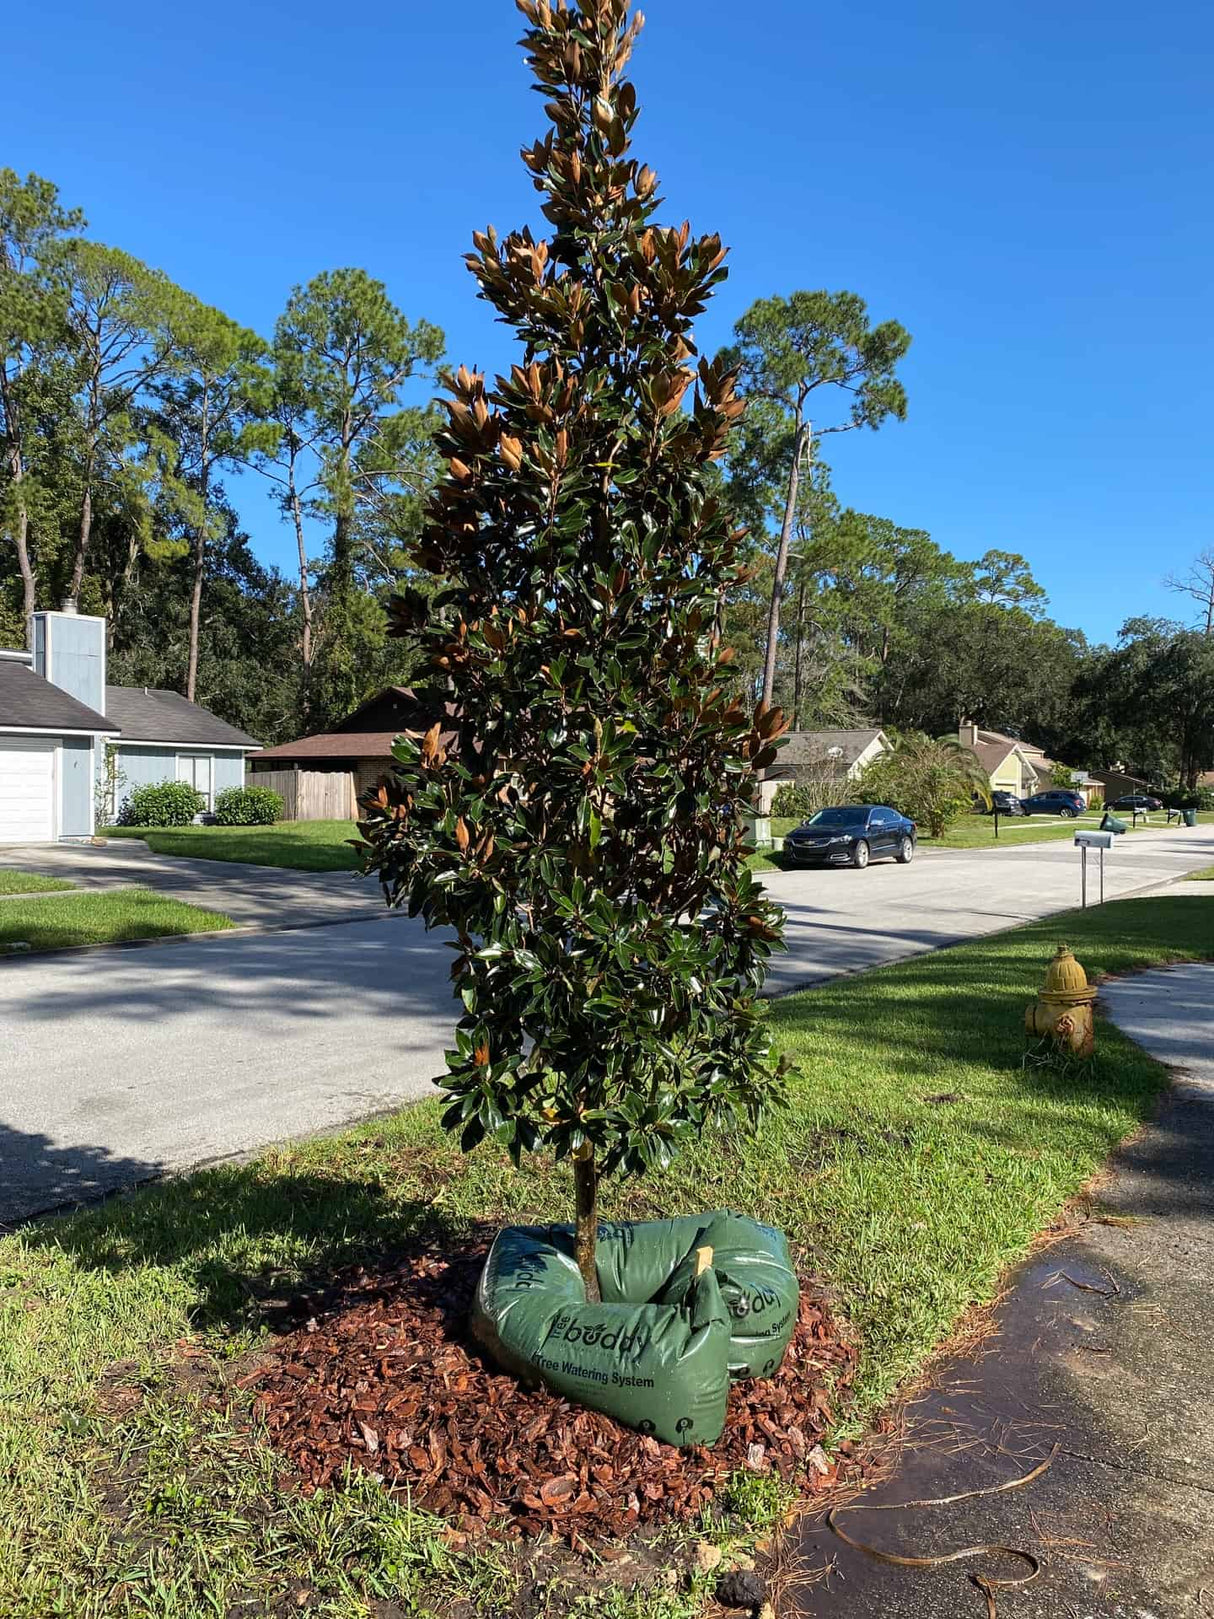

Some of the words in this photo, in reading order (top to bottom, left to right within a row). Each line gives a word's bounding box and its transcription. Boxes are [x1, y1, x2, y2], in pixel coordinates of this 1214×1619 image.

[563, 1318, 651, 1363] buddy
[536, 1354, 559, 1371] Tree
[562, 1361, 608, 1385] Watering
[611, 1372, 654, 1388] System
